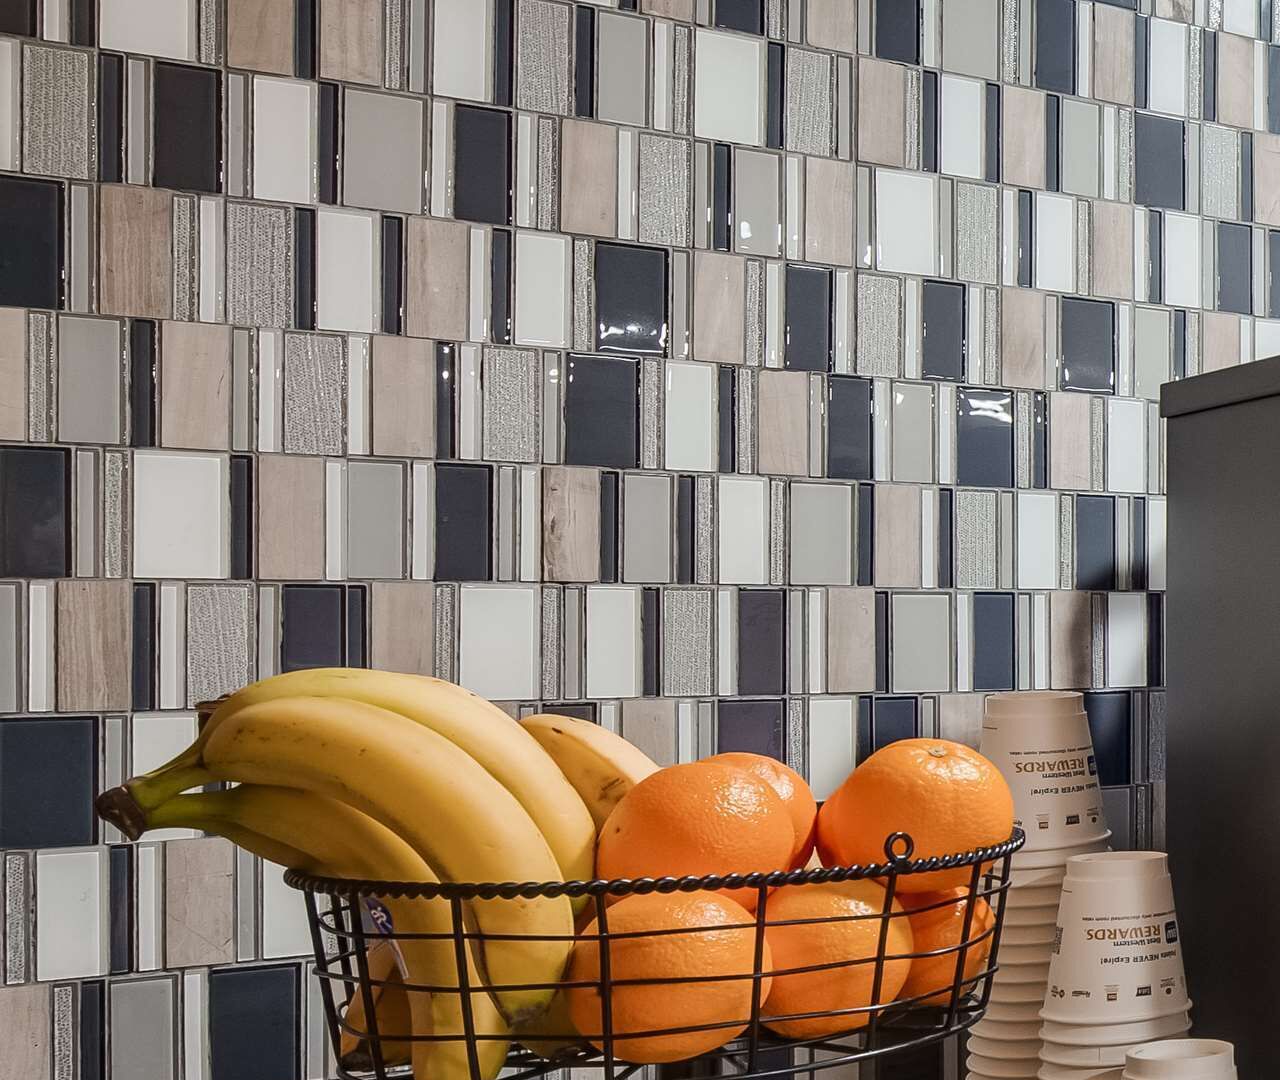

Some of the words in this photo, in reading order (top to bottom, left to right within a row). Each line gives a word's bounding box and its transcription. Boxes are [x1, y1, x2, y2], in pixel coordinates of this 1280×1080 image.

[1015, 758, 1085, 773] REWARDS
[1030, 788, 1059, 796] Expire!
[1061, 786, 1084, 794] NEVER
[1086, 924, 1161, 940] REWARDS
[1100, 955, 1130, 965] Expire!
[1133, 954, 1159, 963] NEVER
